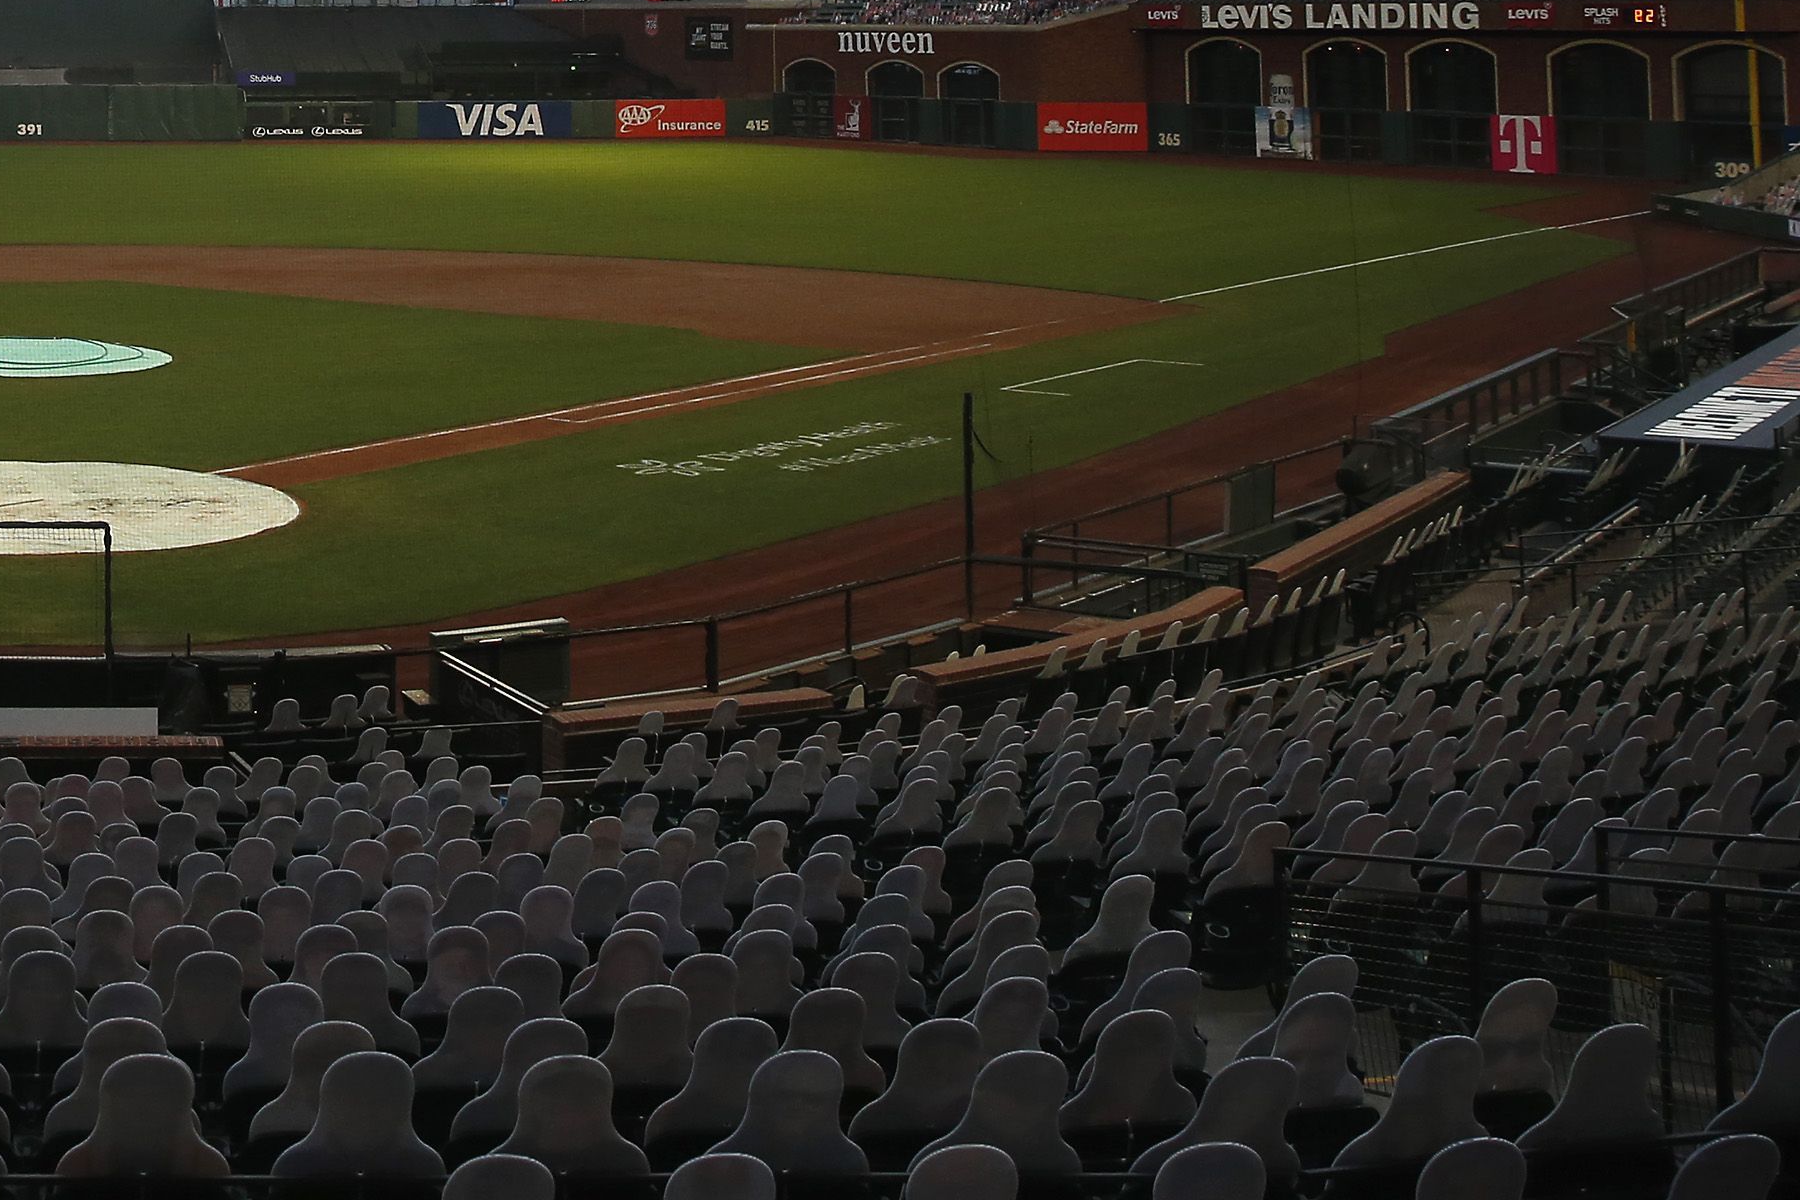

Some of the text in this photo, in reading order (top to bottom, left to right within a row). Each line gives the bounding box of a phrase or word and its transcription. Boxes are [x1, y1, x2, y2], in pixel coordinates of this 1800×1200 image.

[1305, 1, 1480, 30] LANDING
[1583, 7, 1619, 17] SPLASH
[1593, 17, 1611, 25] HITS
[838, 31, 935, 54] nuveen
[249, 74, 282, 83] StubHub
[445, 103, 544, 136] VISA
[657, 119, 721, 131] Insurance
[745, 120, 769, 131] 415
[17, 124, 43, 136] 391
[1158, 133, 1181, 146] 365
[1714, 161, 1751, 178] 309
[1643, 397, 1792, 441] WELCOME
